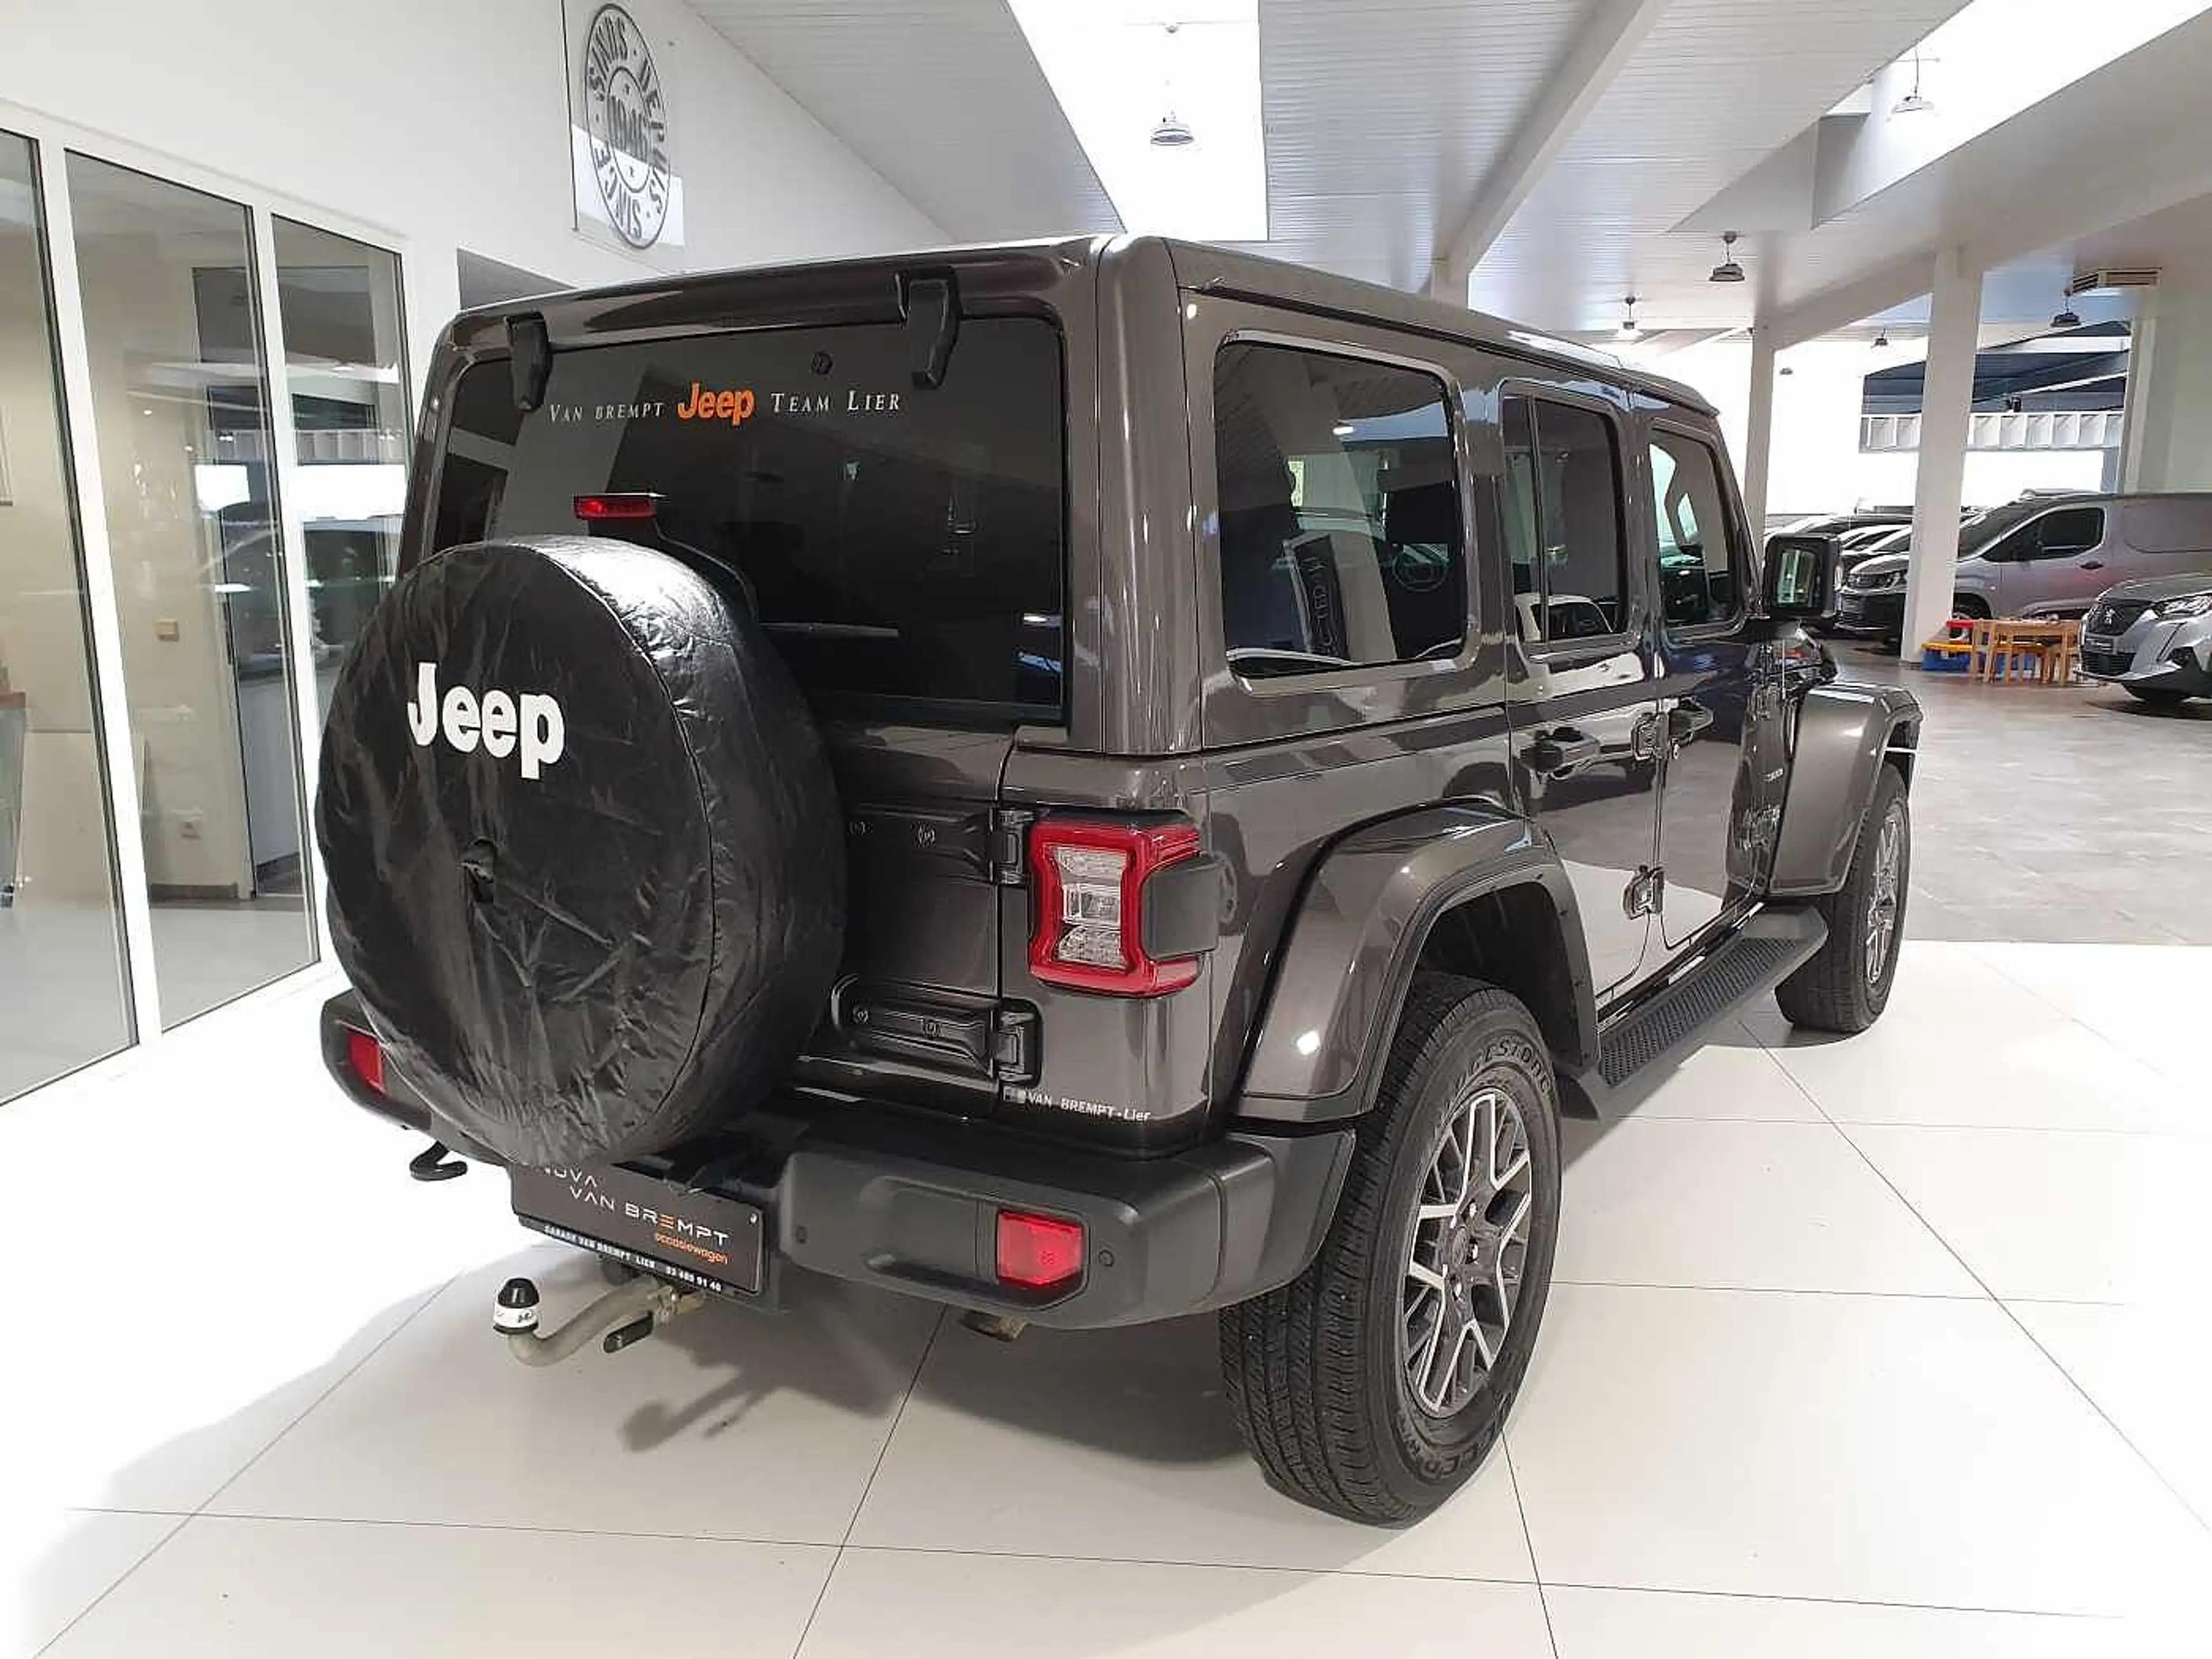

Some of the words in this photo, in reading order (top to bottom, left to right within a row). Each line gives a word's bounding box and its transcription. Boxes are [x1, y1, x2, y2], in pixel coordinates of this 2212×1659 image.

[677, 381, 755, 425] Jeep
[407, 662, 565, 779] Jeep
[1028, 1092, 1052, 1107] VAN
[570, 1185, 615, 1211] VAN
[625, 1202, 729, 1247] BREMPT
